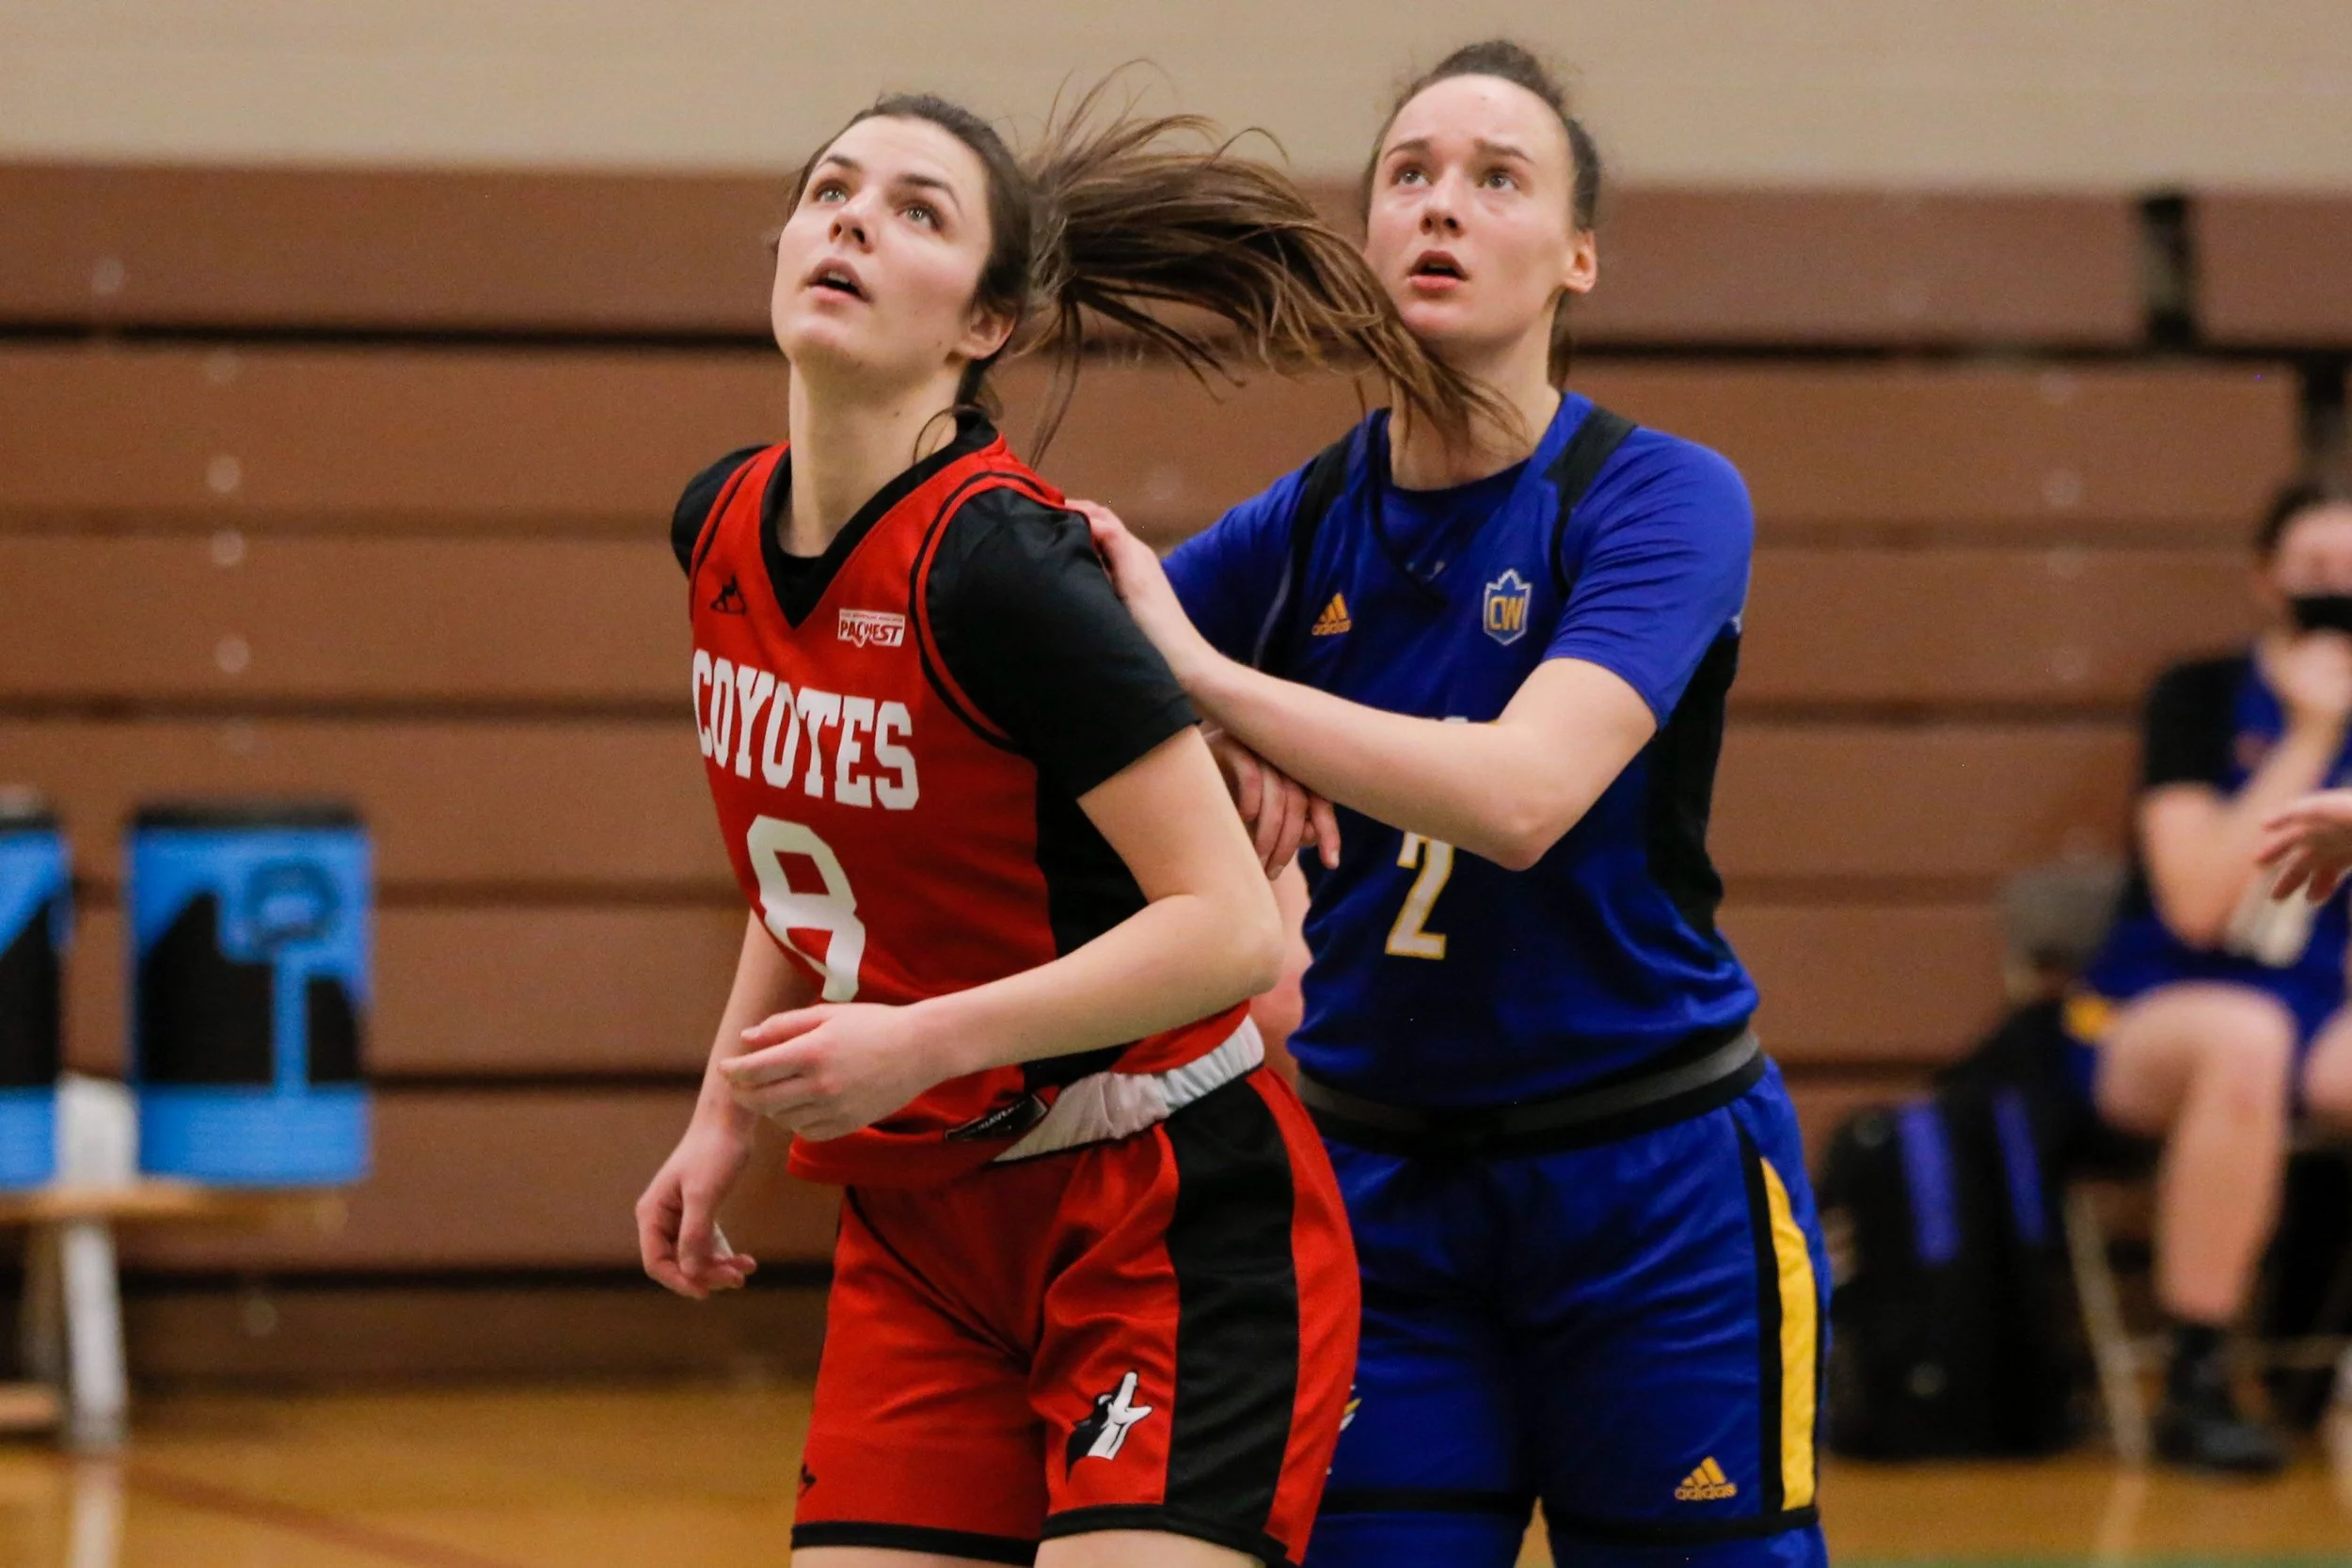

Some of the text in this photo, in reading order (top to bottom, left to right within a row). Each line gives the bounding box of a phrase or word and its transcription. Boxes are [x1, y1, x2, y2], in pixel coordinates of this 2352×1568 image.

[839, 620, 903, 643] PACWEST
[1489, 596, 1525, 631] CW
[692, 649, 919, 810] COYOTES
[747, 815, 866, 1003] 8
[1385, 831, 1454, 960] 2
[1675, 1482, 1737, 1501] adidas
